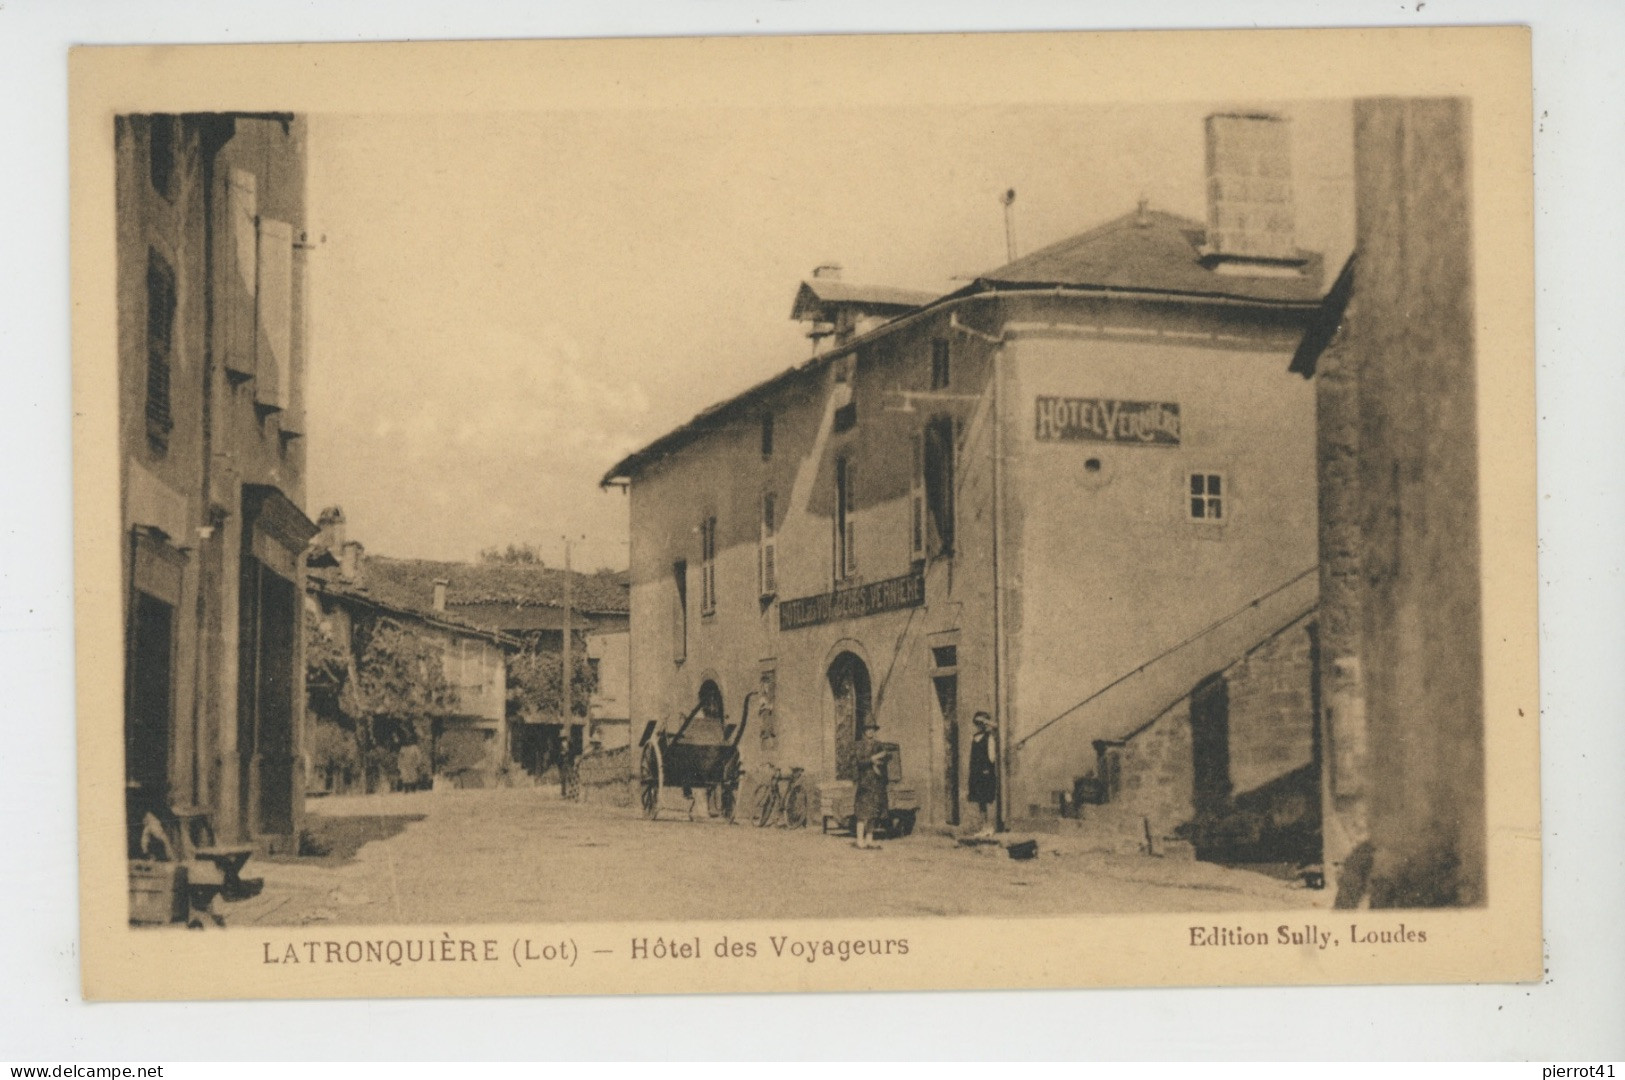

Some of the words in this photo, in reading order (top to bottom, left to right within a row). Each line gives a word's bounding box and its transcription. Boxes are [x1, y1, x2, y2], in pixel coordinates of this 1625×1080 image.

[263, 932, 499, 966] LATRONQUIÈRE
[513, 940, 578, 966] (Lot)
[631, 937, 701, 959] Hôtel
[715, 936, 757, 958] des
[770, 936, 909, 963] Voyageurs
[1189, 926, 1269, 946] Edition
[1277, 924, 1339, 950] Sully,
[1350, 923, 1427, 944] Loudes
